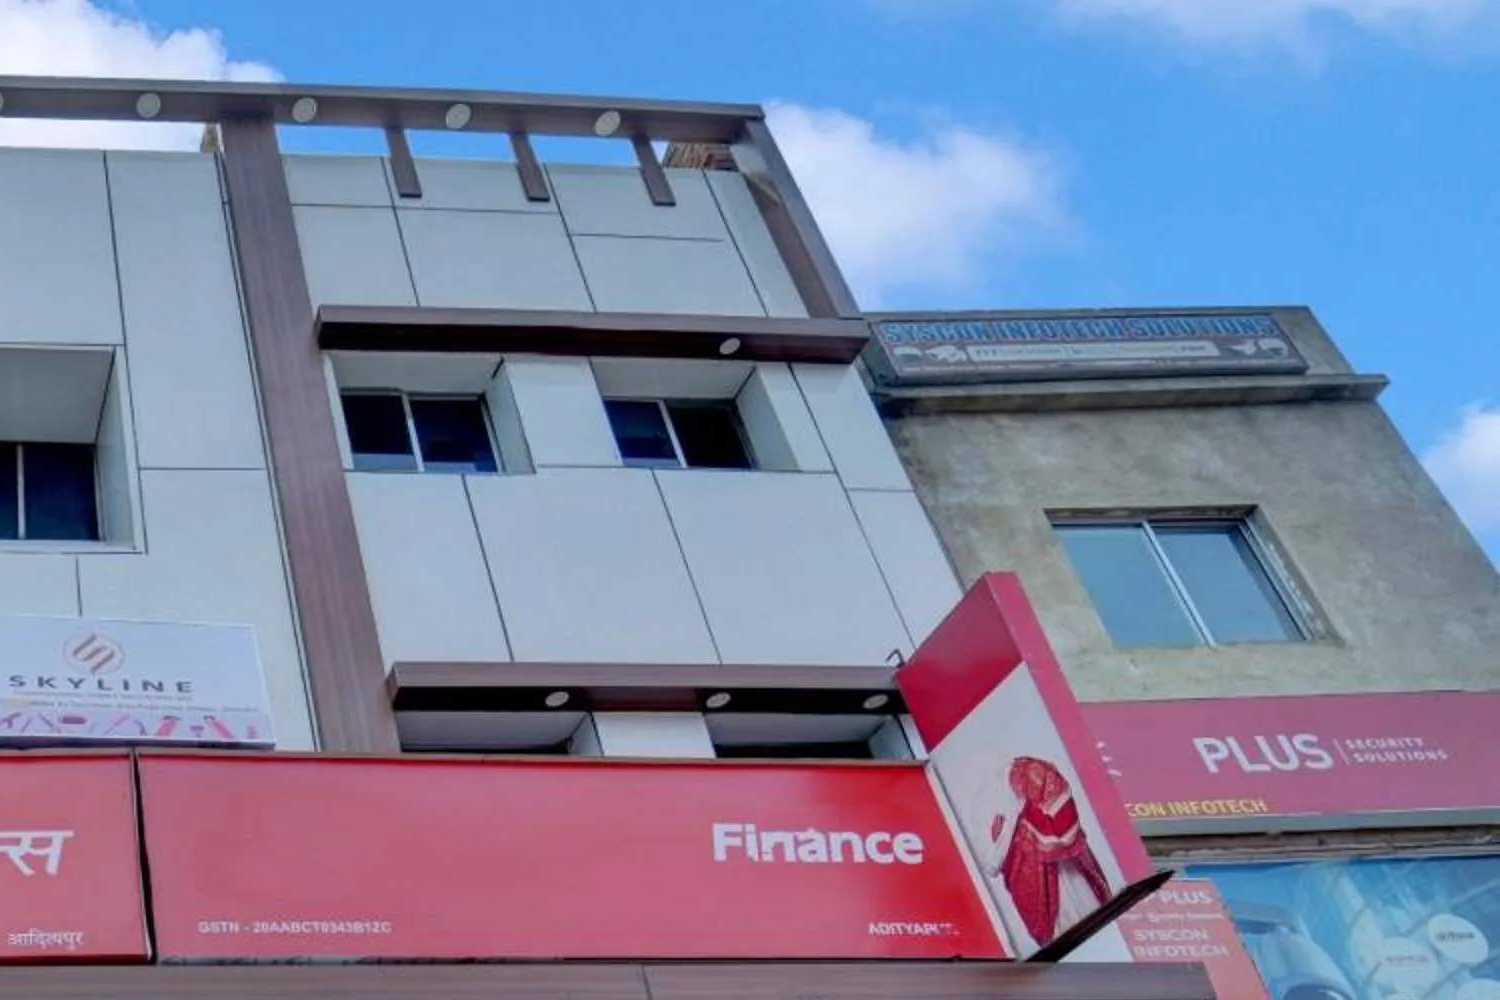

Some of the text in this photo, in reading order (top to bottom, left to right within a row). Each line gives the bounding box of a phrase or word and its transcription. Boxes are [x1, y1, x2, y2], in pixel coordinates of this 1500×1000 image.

[8, 675, 195, 693] SKYLINE
[1192, 734, 1333, 774] PLUS
[1353, 749, 1448, 762] SOLUTIONS
[1168, 798, 1268, 817] INFOTECH
[713, 822, 925, 866] Finance
[198, 921, 240, 933] GSTN
